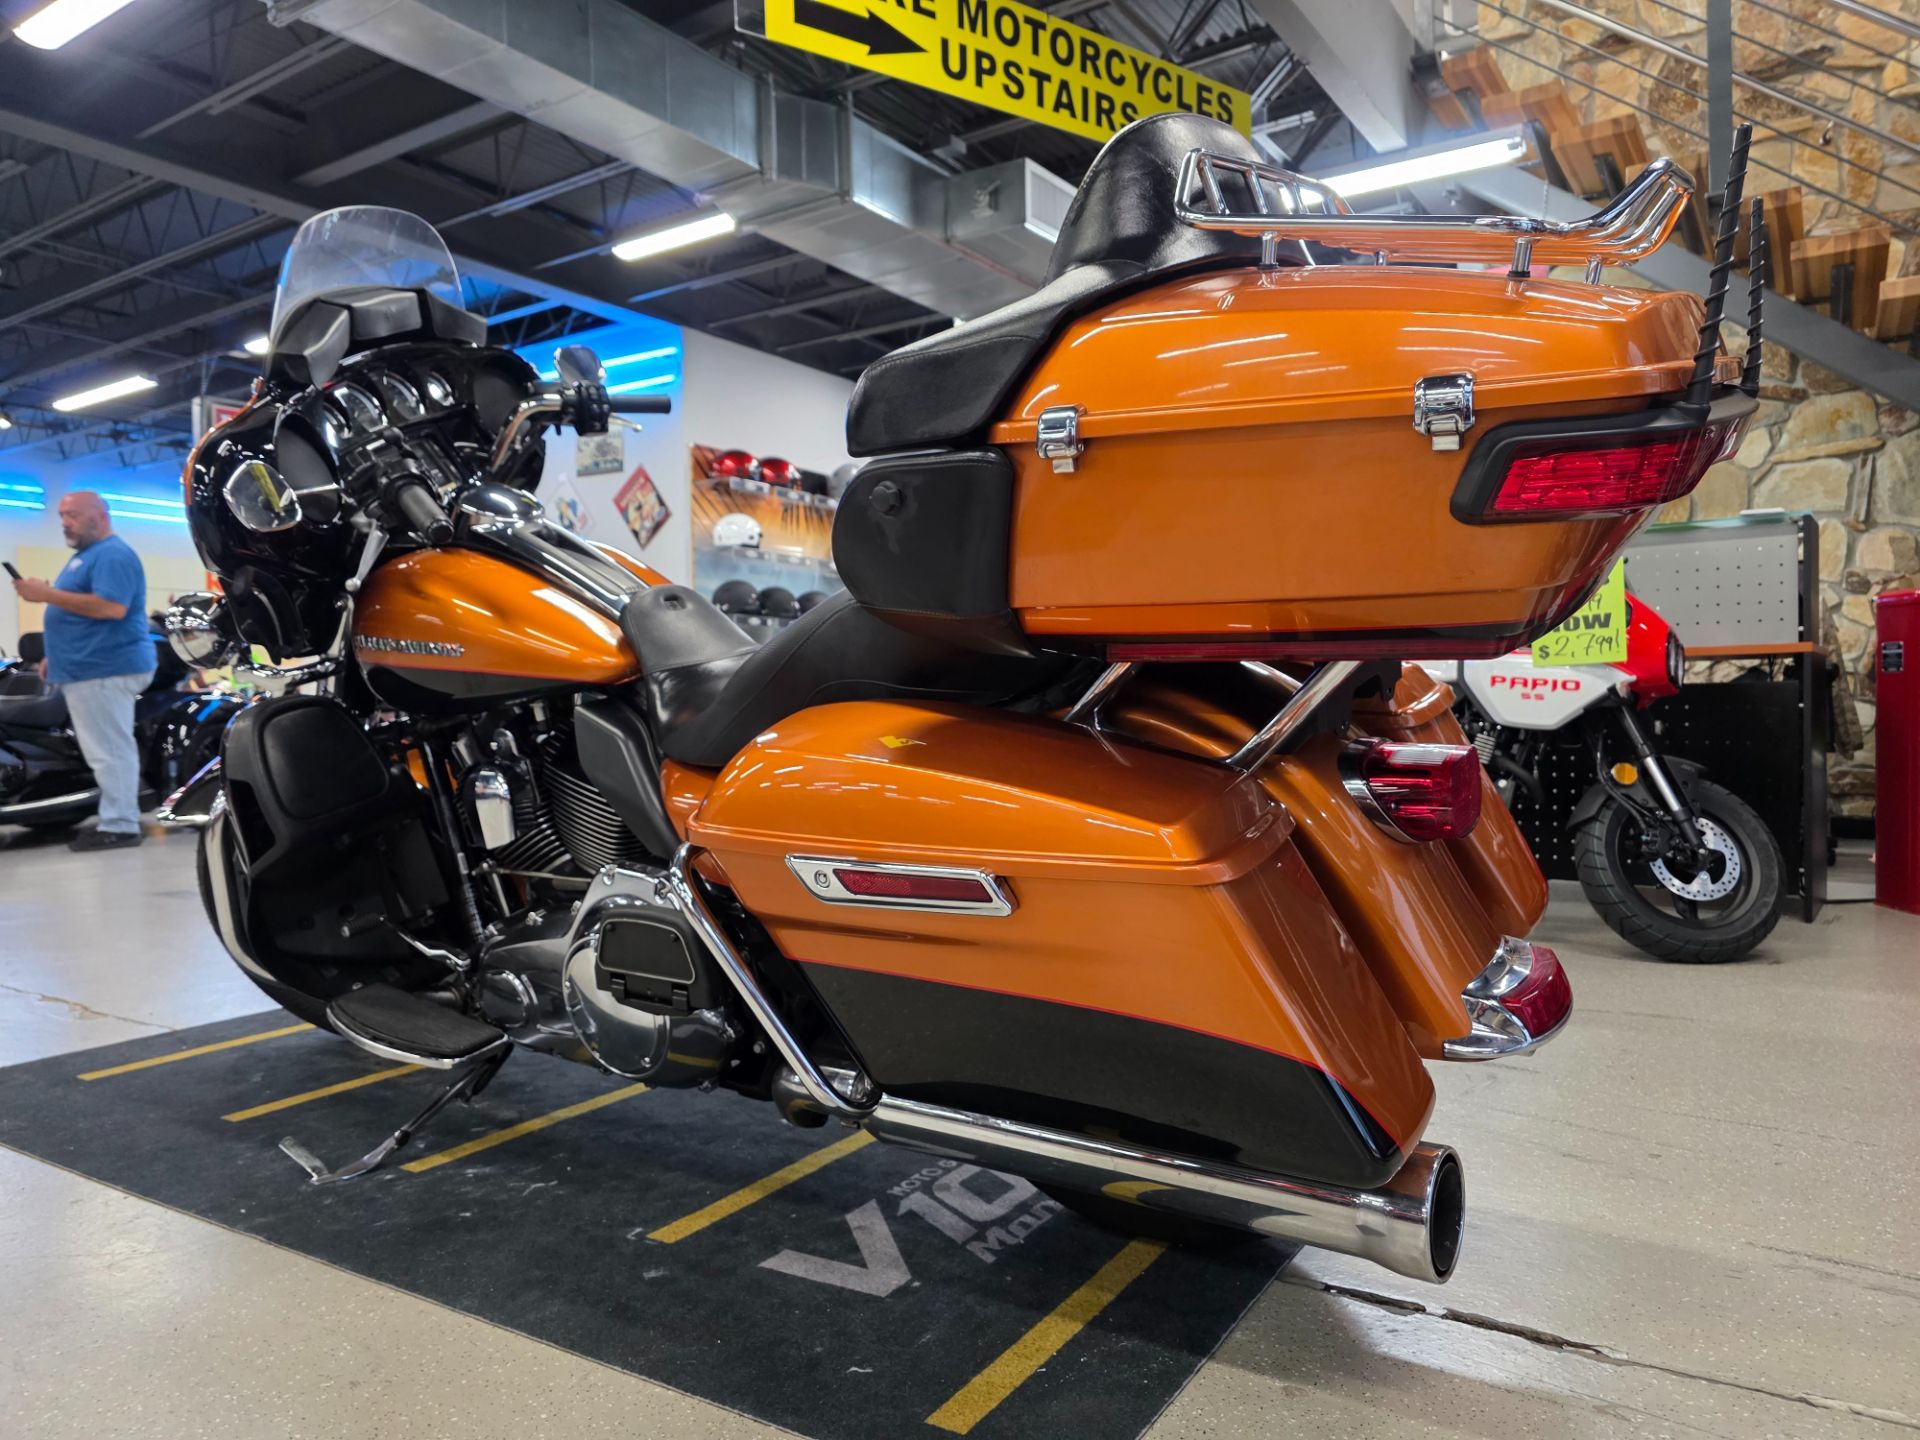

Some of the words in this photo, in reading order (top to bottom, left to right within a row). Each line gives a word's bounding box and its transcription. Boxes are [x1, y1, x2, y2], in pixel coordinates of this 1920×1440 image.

[957, 0, 1233, 125] MOTORCYCLES
[940, 37, 1139, 131] UPSTAIRS
[1552, 612, 1612, 632] OW
[1490, 675, 1580, 692] PAPIO
[887, 1167, 943, 1197] MOTO
